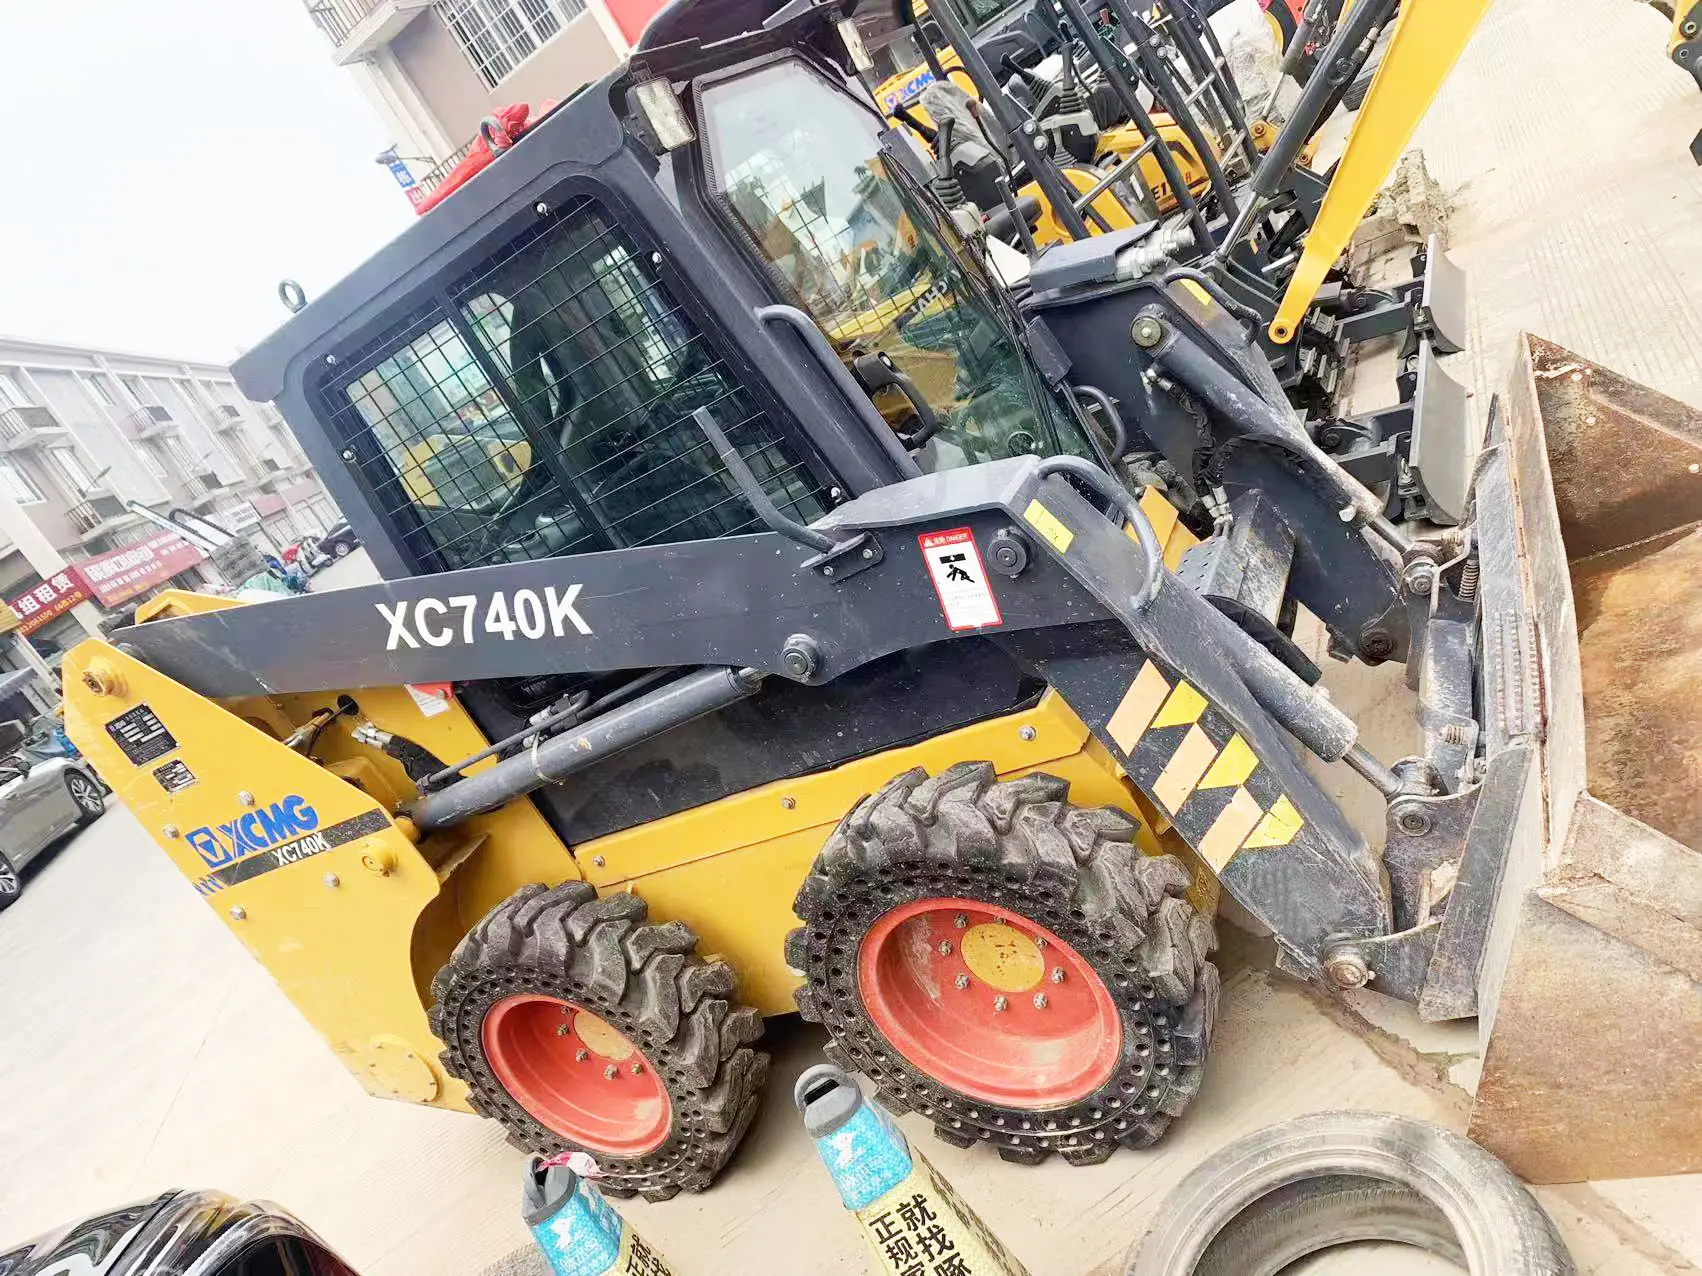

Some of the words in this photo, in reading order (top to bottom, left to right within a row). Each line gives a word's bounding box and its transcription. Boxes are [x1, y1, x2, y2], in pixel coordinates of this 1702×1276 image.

[945, 532, 968, 543] DANGER
[375, 583, 593, 650] XC740K
[216, 795, 319, 859] XCMG
[272, 832, 331, 867] XC740K
